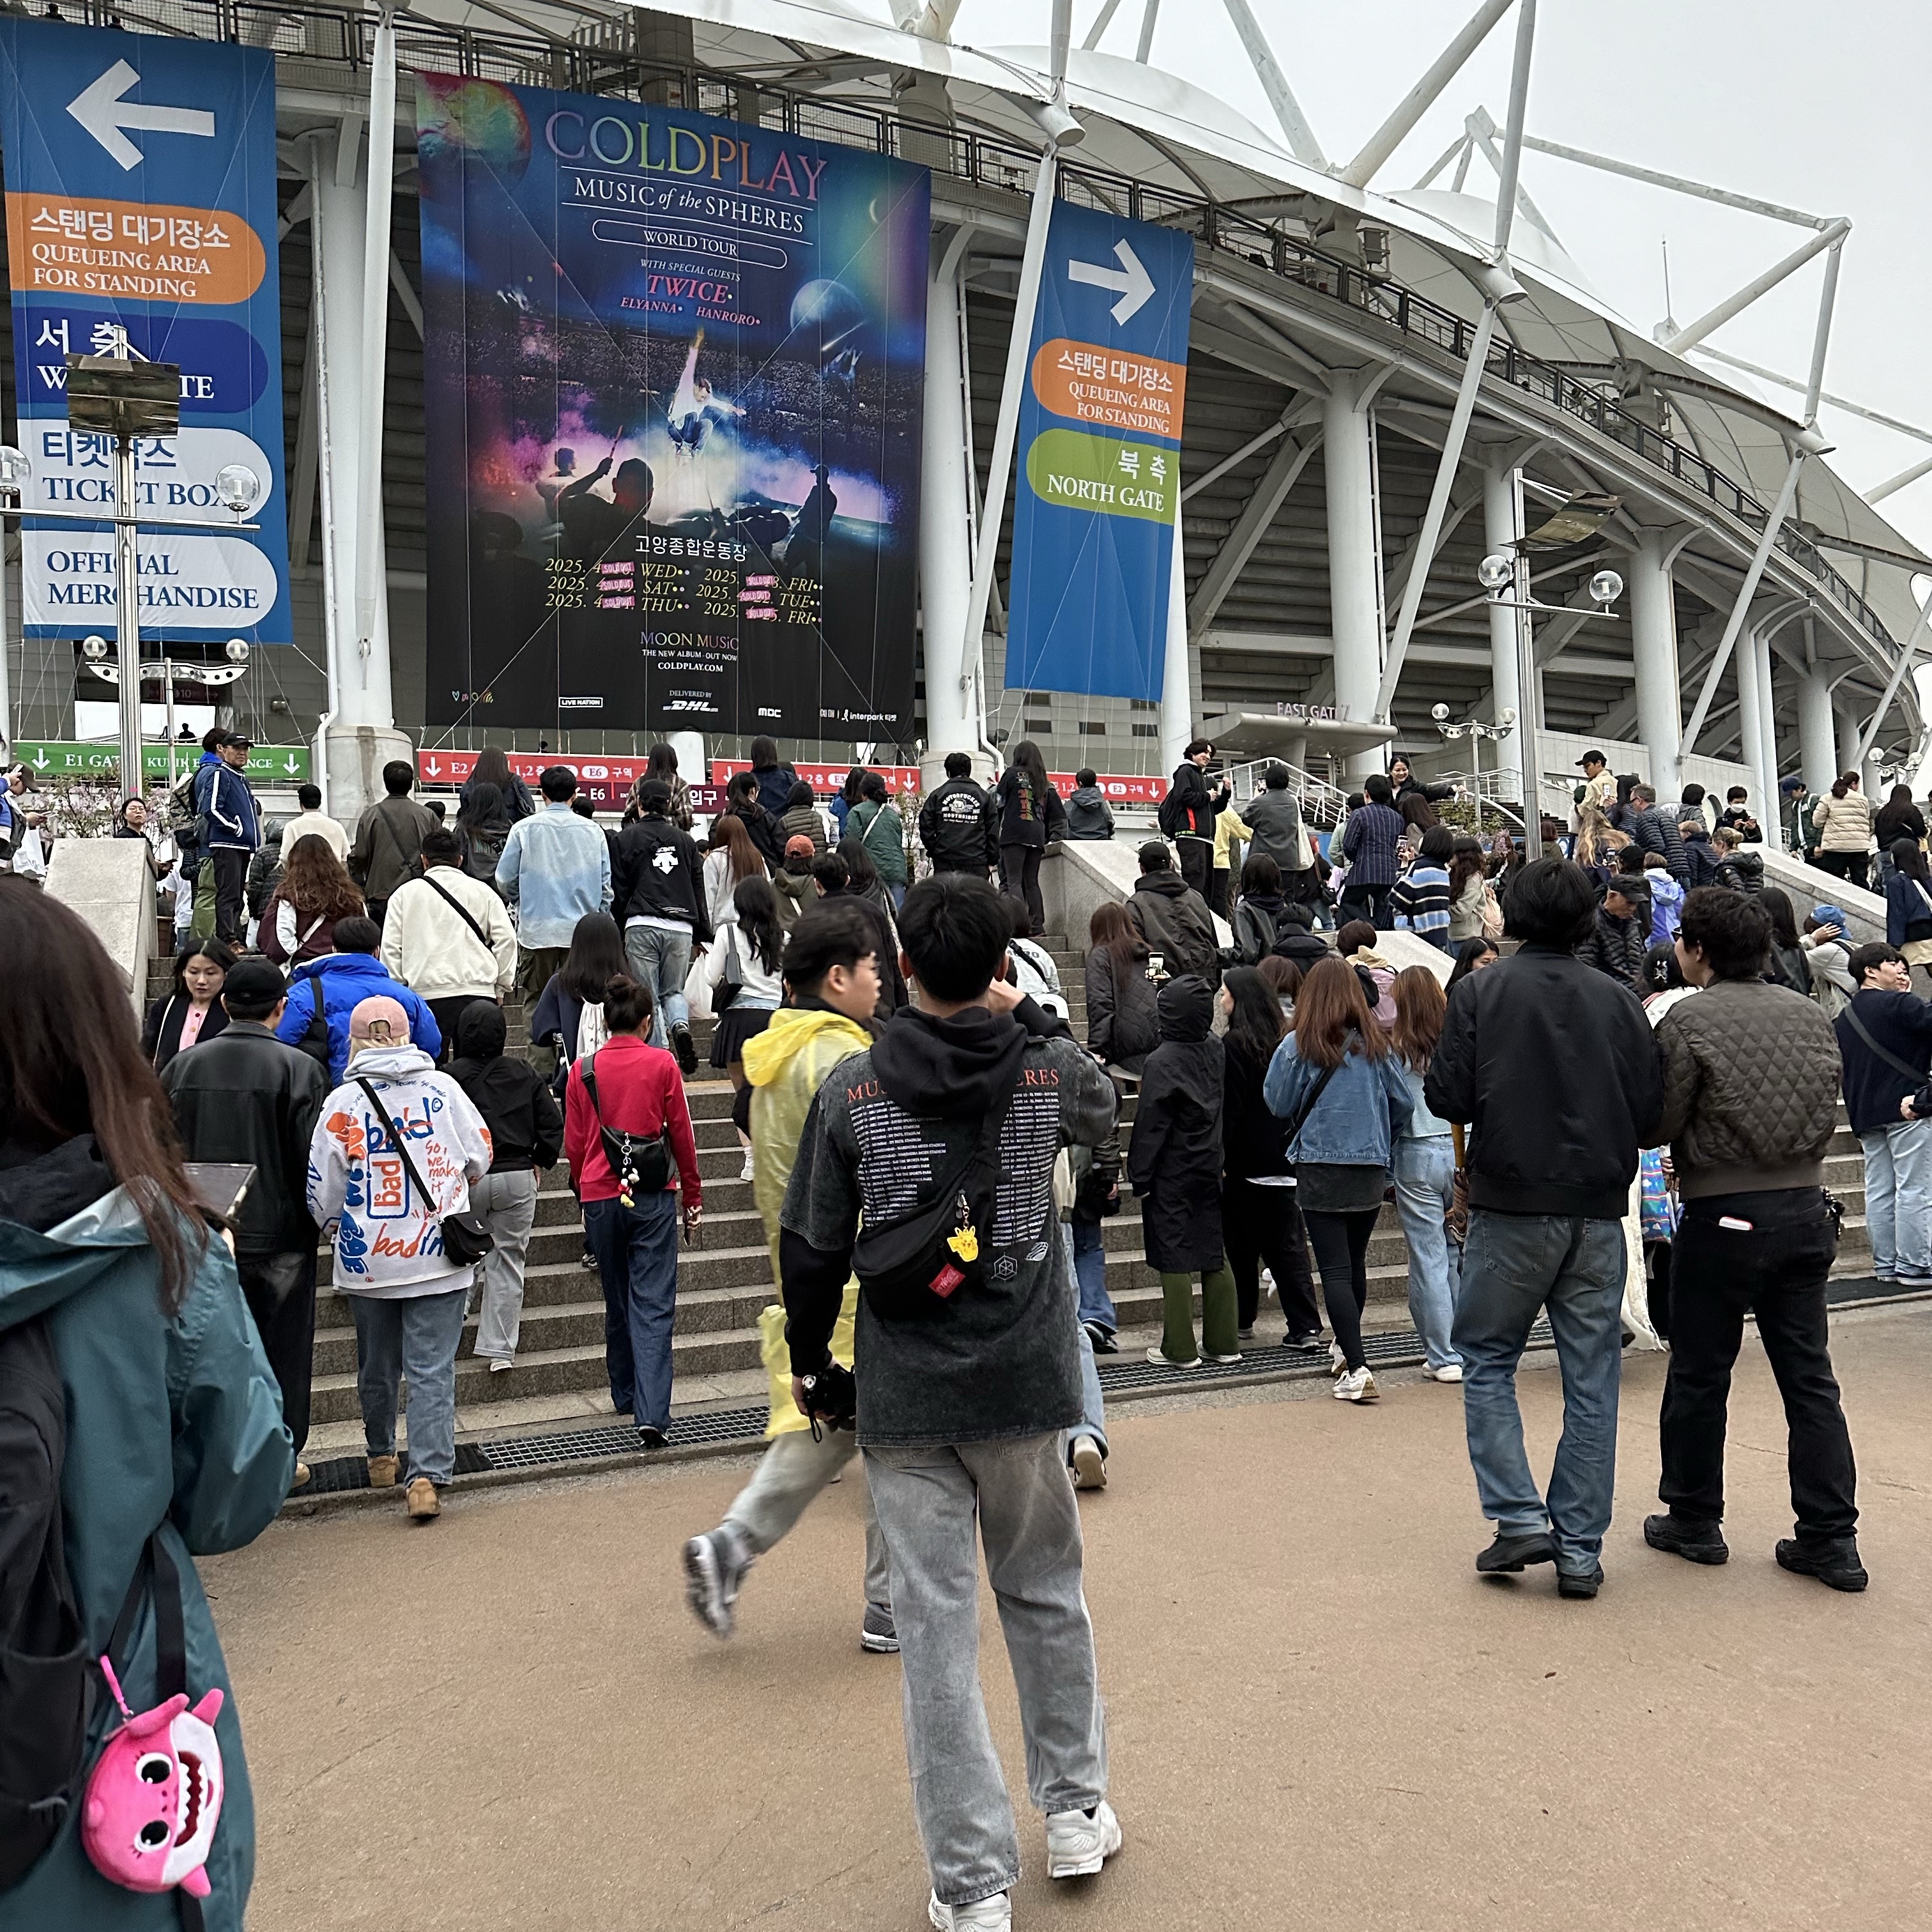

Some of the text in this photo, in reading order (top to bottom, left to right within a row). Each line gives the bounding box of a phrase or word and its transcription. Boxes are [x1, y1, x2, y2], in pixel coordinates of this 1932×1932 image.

[546, 111, 827, 201] COLDPLAY
[575, 176, 804, 233] MUSIC of the SPHERES
[31, 208, 231, 249] 스탠딩 대기장소
[643, 229, 737, 256] WORLD TOUR
[32, 243, 211, 275] QUEUEING AREA
[640, 259, 741, 282] WITH SPECIAL GUESTS
[33, 268, 197, 298] FOR STANDING
[647, 275, 728, 303] TWICE
[620, 296, 756, 326] ELYANNA HANRORO
[1057, 349, 1173, 393] 스탠딩 대기장소
[1069, 381, 1171, 415] QUEUEING AREA
[1077, 402, 1170, 434] FOR STANDING
[1047, 474, 1165, 512] NORTH GATE
[634, 535, 748, 562] 고양종합운동장
[47, 551, 179, 575] OFFIIAL
[47, 583, 259, 609] MERHANDISE
[640, 631, 693, 647] MOON
[642, 648, 738, 662] THE NEW ALBUM OUT NOW
[657, 661, 723, 673] COLDPLAY.COM
[671, 700, 711, 712] DHL
[758, 707, 782, 718] MBC
[850, 712, 884, 722] interpark
[1277, 702, 1307, 717] EAST
[89, 755, 121, 767] GAT
[450, 762, 468, 774] E2
[589, 768, 602, 777] E6
[612, 767, 632, 778] 구역
[590, 788, 606, 801] E6
[691, 790, 717, 806] 입구
[429, 1159, 459, 1177] make
